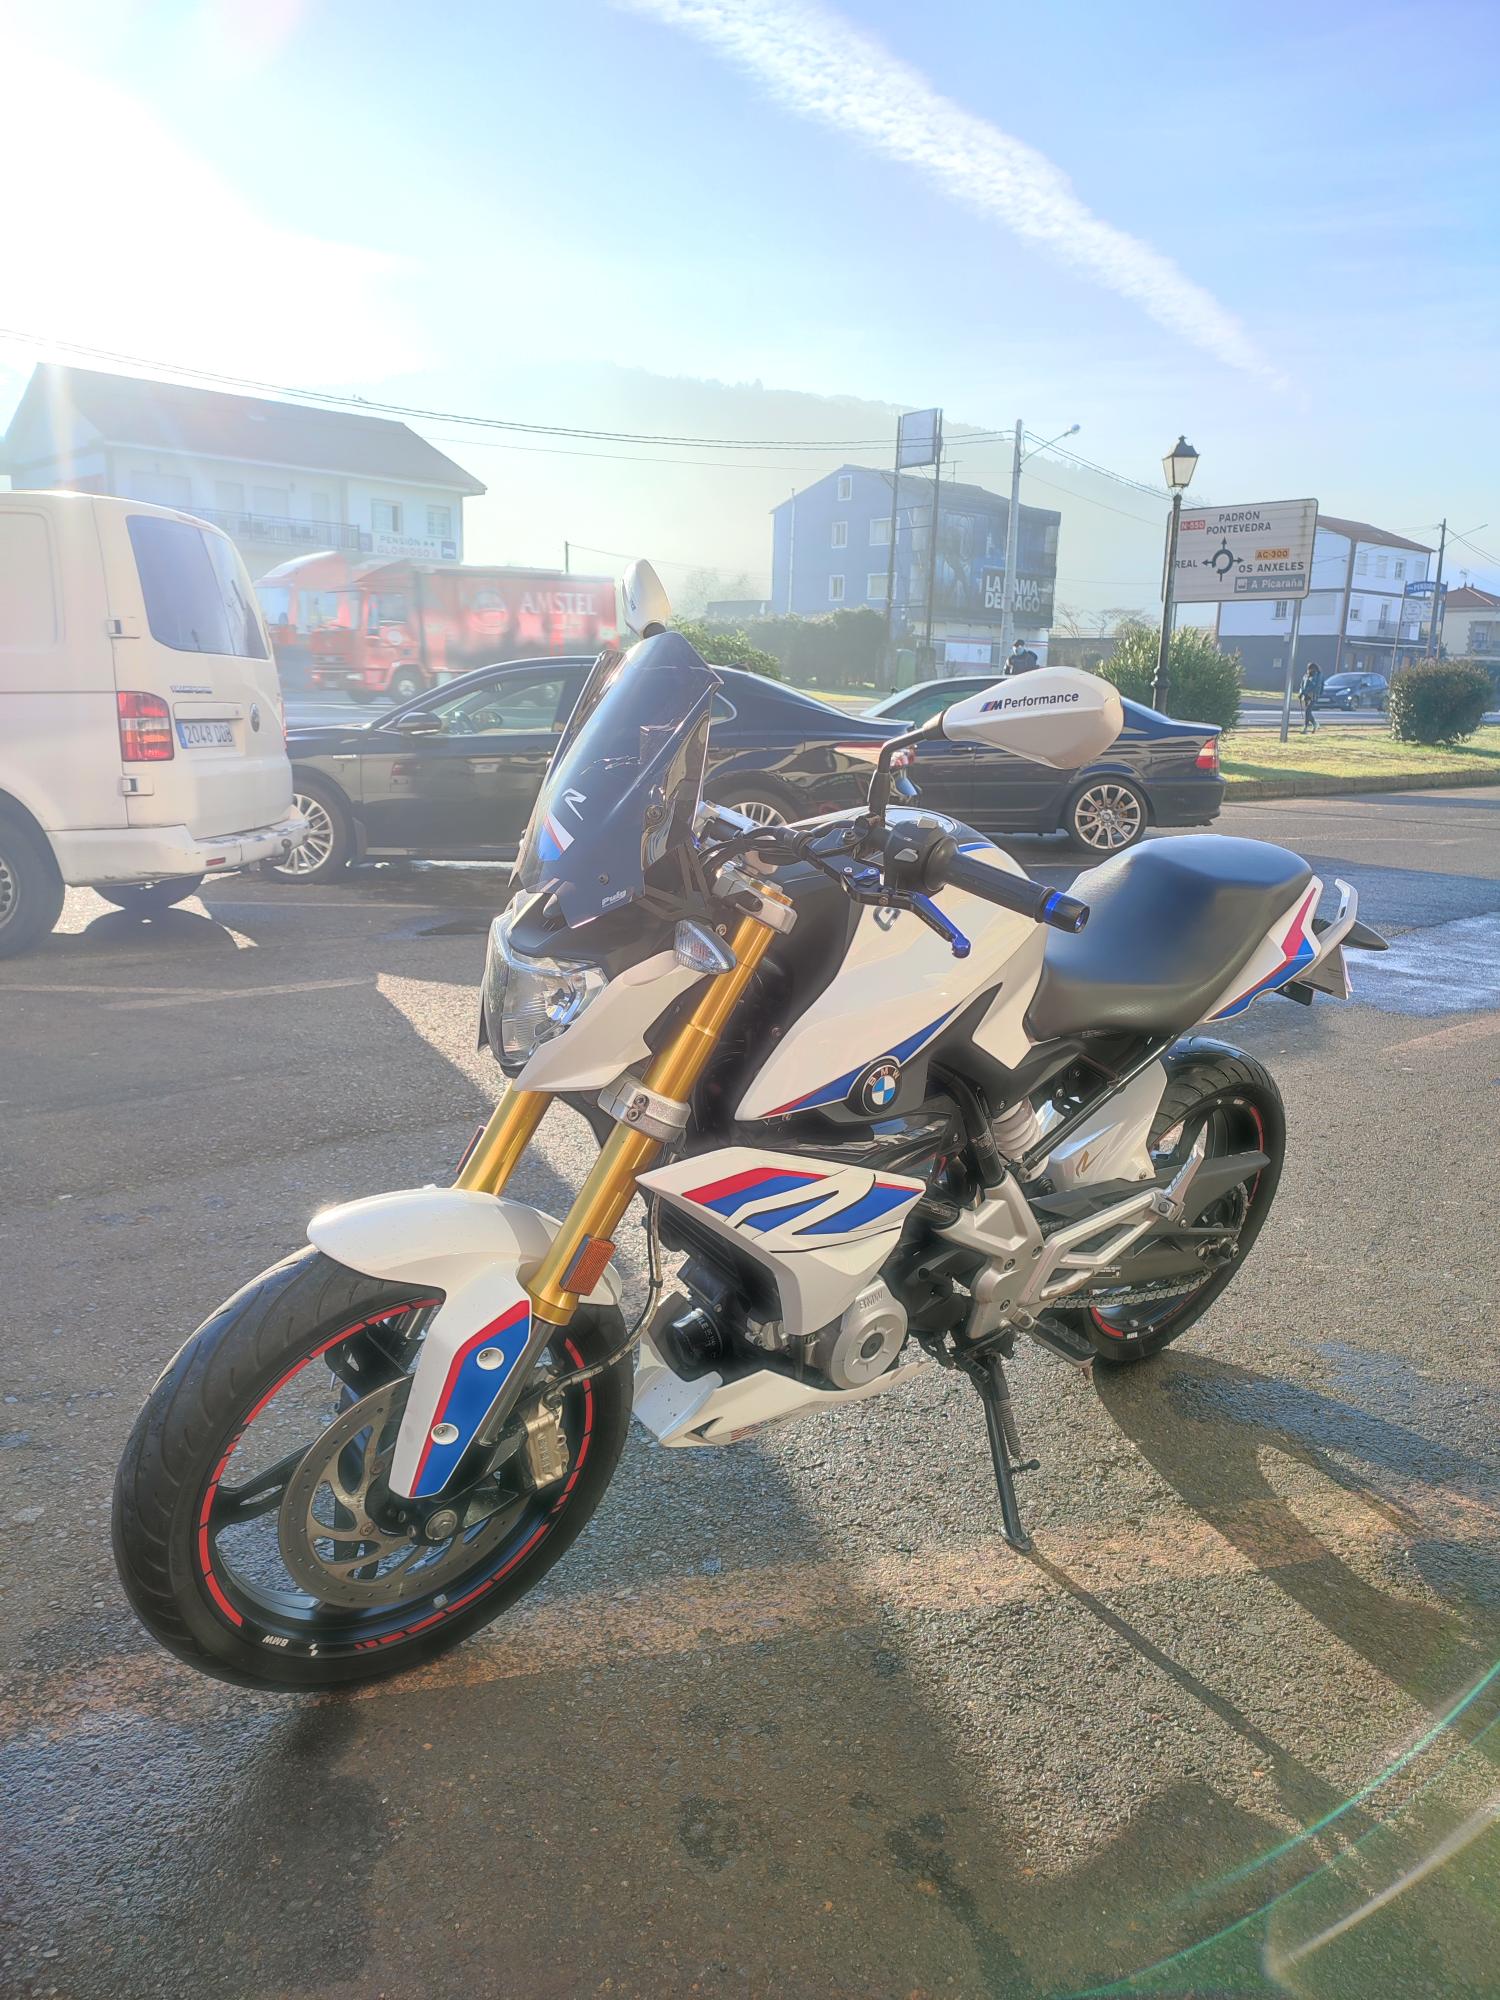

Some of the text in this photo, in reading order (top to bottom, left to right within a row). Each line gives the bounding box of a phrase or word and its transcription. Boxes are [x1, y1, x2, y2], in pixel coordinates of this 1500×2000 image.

[1218, 510, 1260, 522] PADRÓN
[1206, 522, 1271, 535] PONTEVEDRA
[1238, 561, 1304, 573] OS ANXELES
[986, 575, 1001, 592] LA
[1251, 580, 1258, 589] A
[519, 592, 597, 615] AMSTEL
[1004, 692, 1079, 709] Performance
[601, 889, 627, 907] Puig
[867, 1066, 901, 1086] BMW
[262, 1634, 289, 1647] BMW
